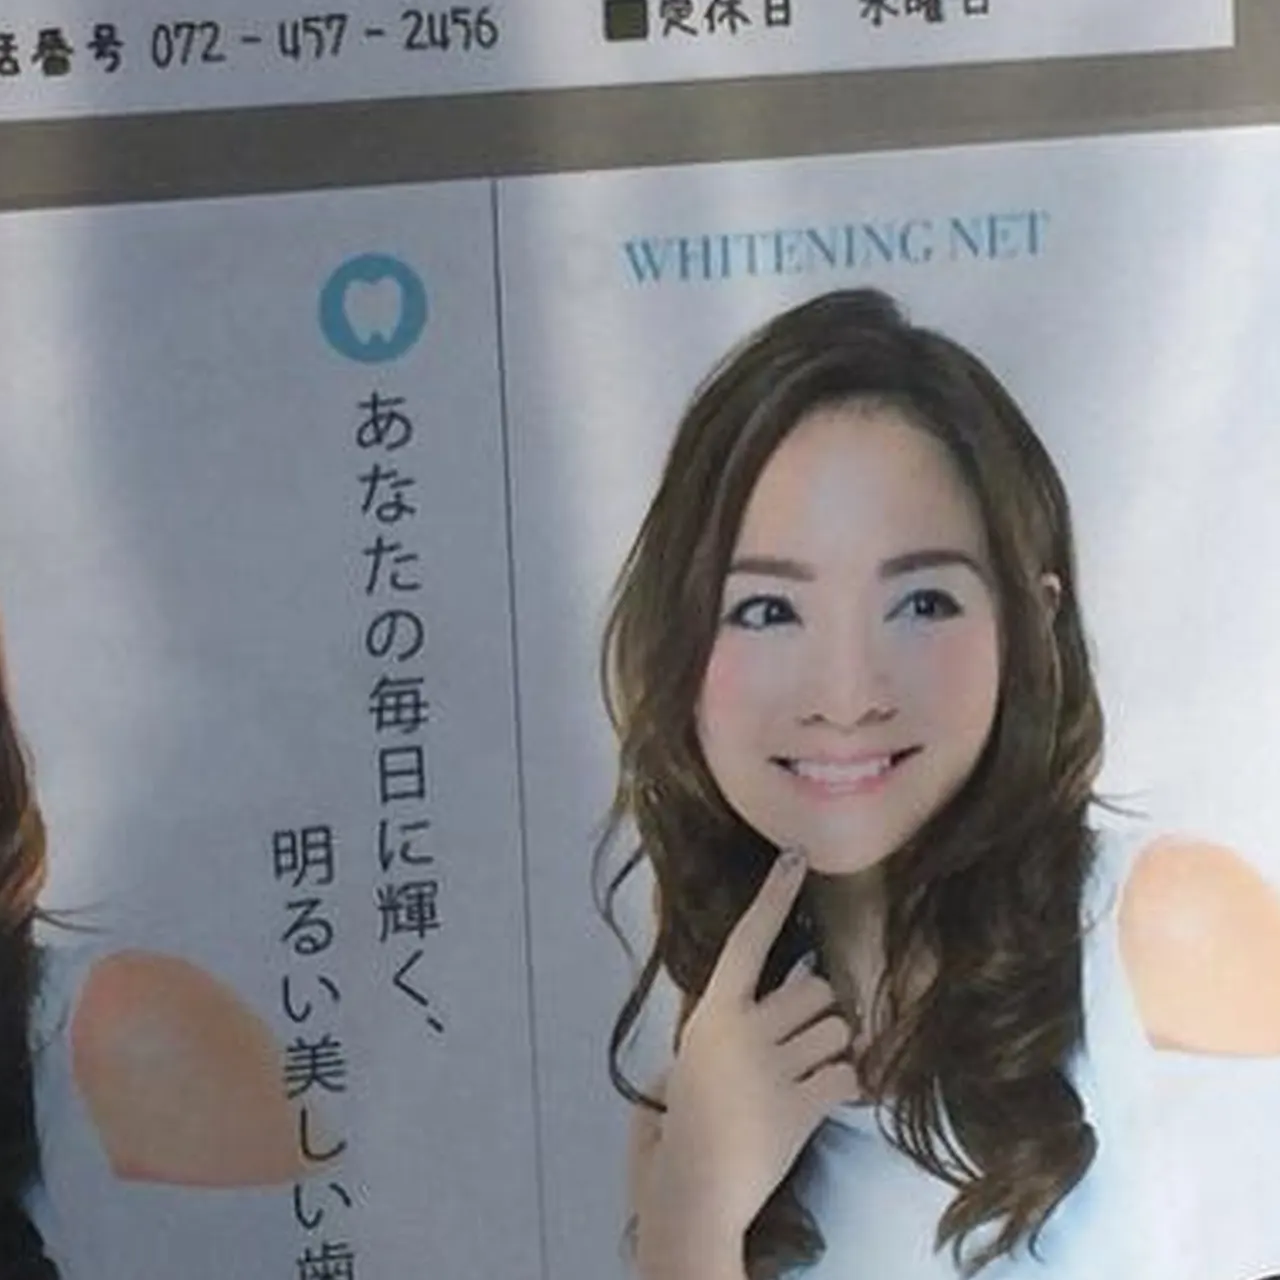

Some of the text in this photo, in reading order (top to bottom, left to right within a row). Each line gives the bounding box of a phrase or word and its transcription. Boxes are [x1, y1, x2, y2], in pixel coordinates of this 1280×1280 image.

[621, 208, 1051, 285] WHITENING NET
[353, 390, 445, 1034] あなたの毎日に輝く、
